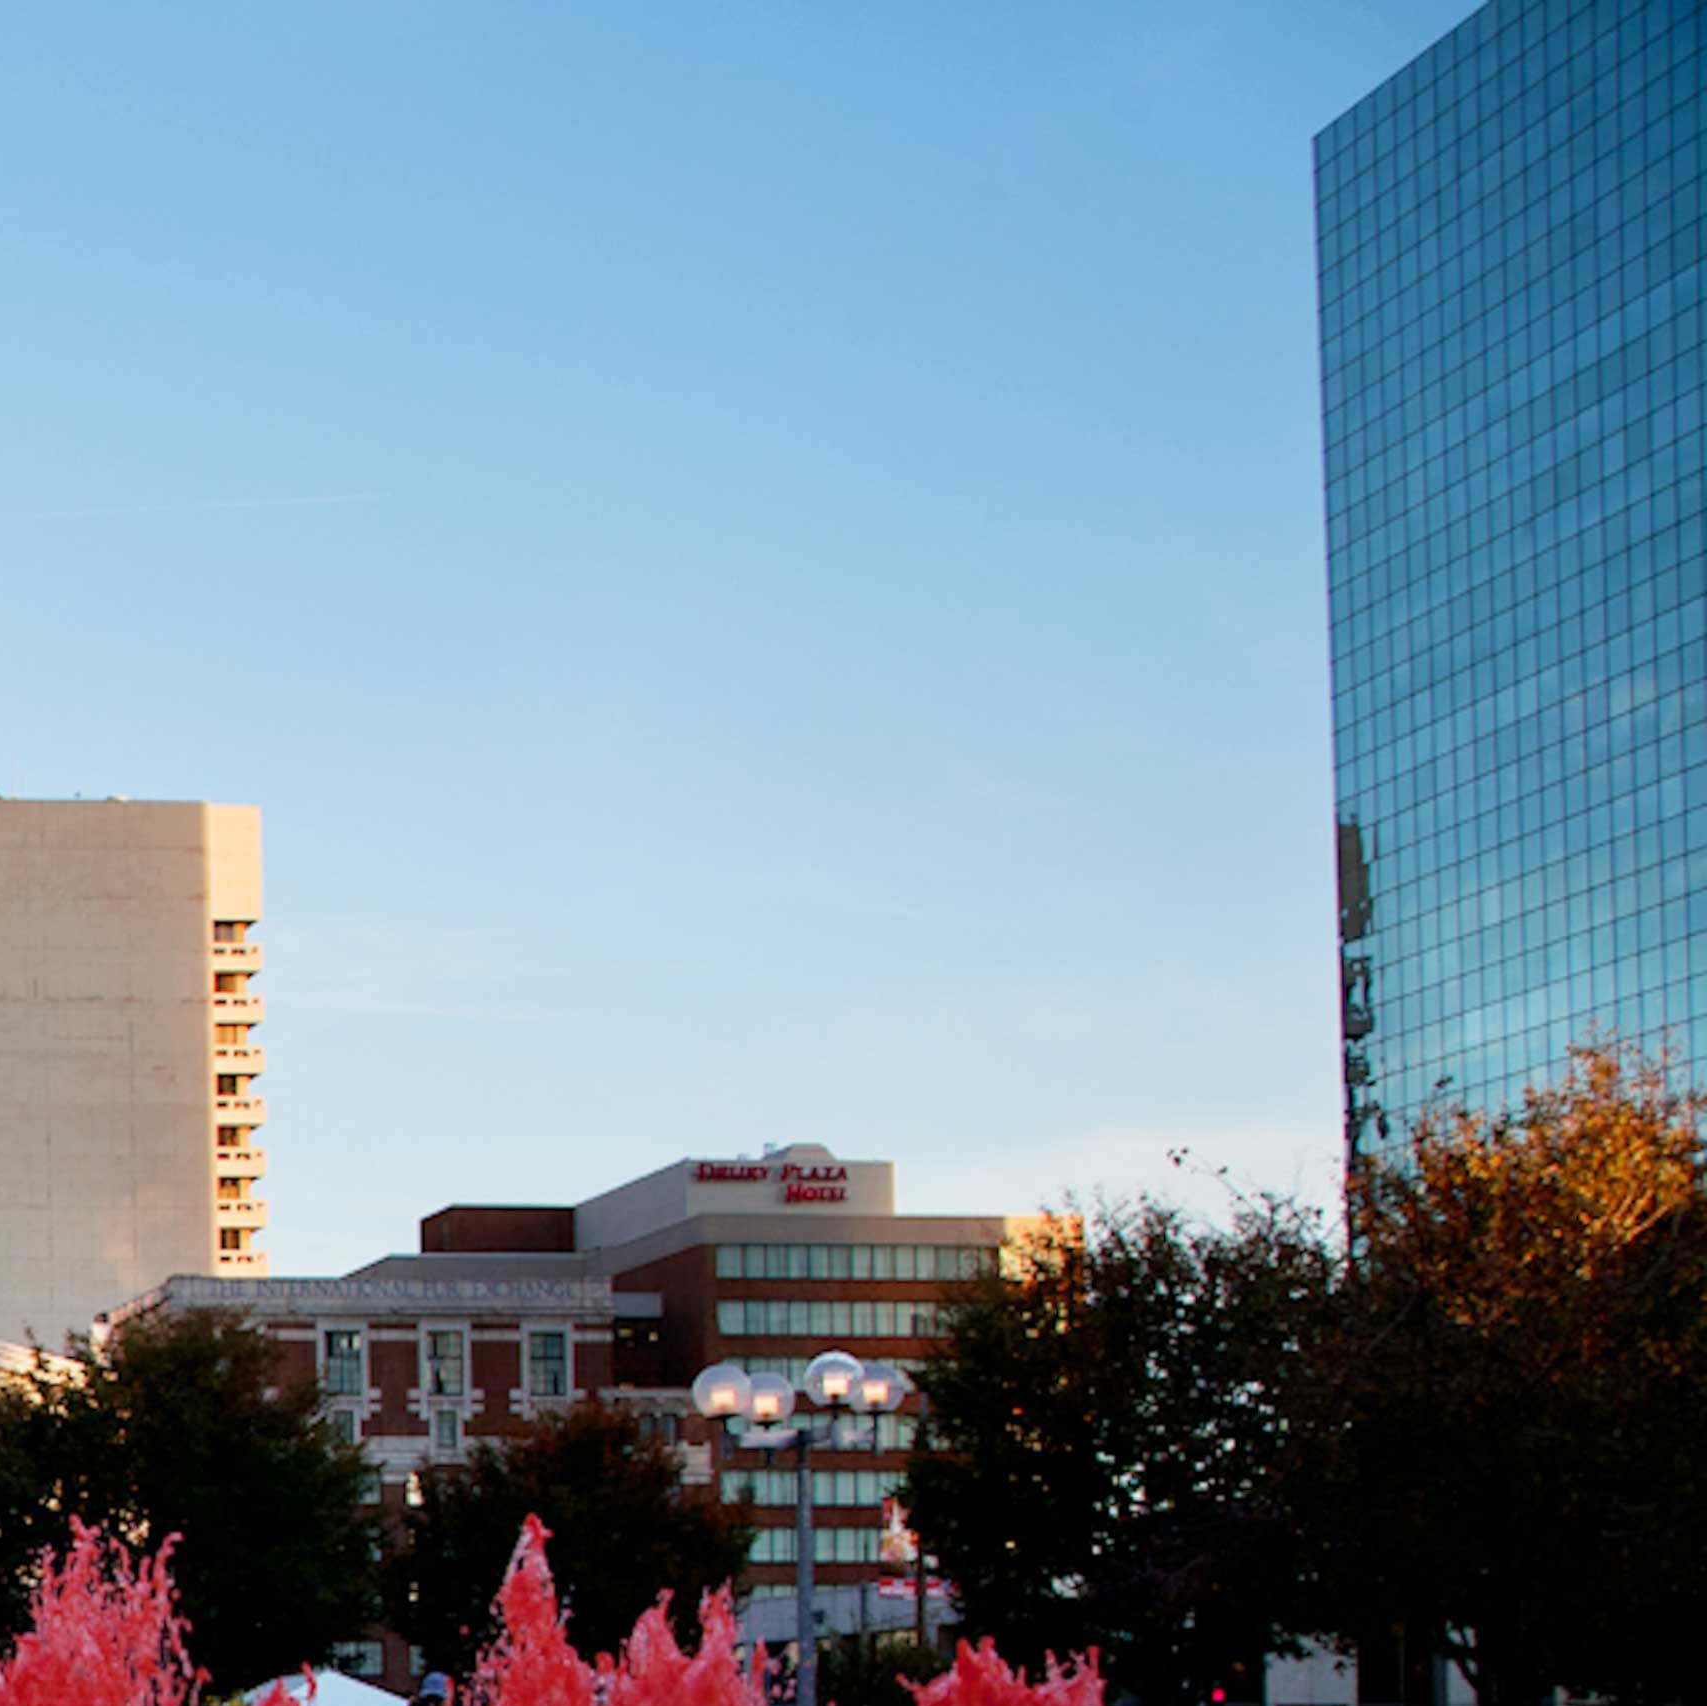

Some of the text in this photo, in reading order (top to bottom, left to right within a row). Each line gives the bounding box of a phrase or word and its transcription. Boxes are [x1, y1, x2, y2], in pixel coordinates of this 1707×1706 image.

[780, 1164, 848, 1181] PLAZA
[785, 1184, 847, 1203] HOTEL
[209, 1280, 244, 1297] THE
[256, 1280, 412, 1297] INTERNATIONAL
